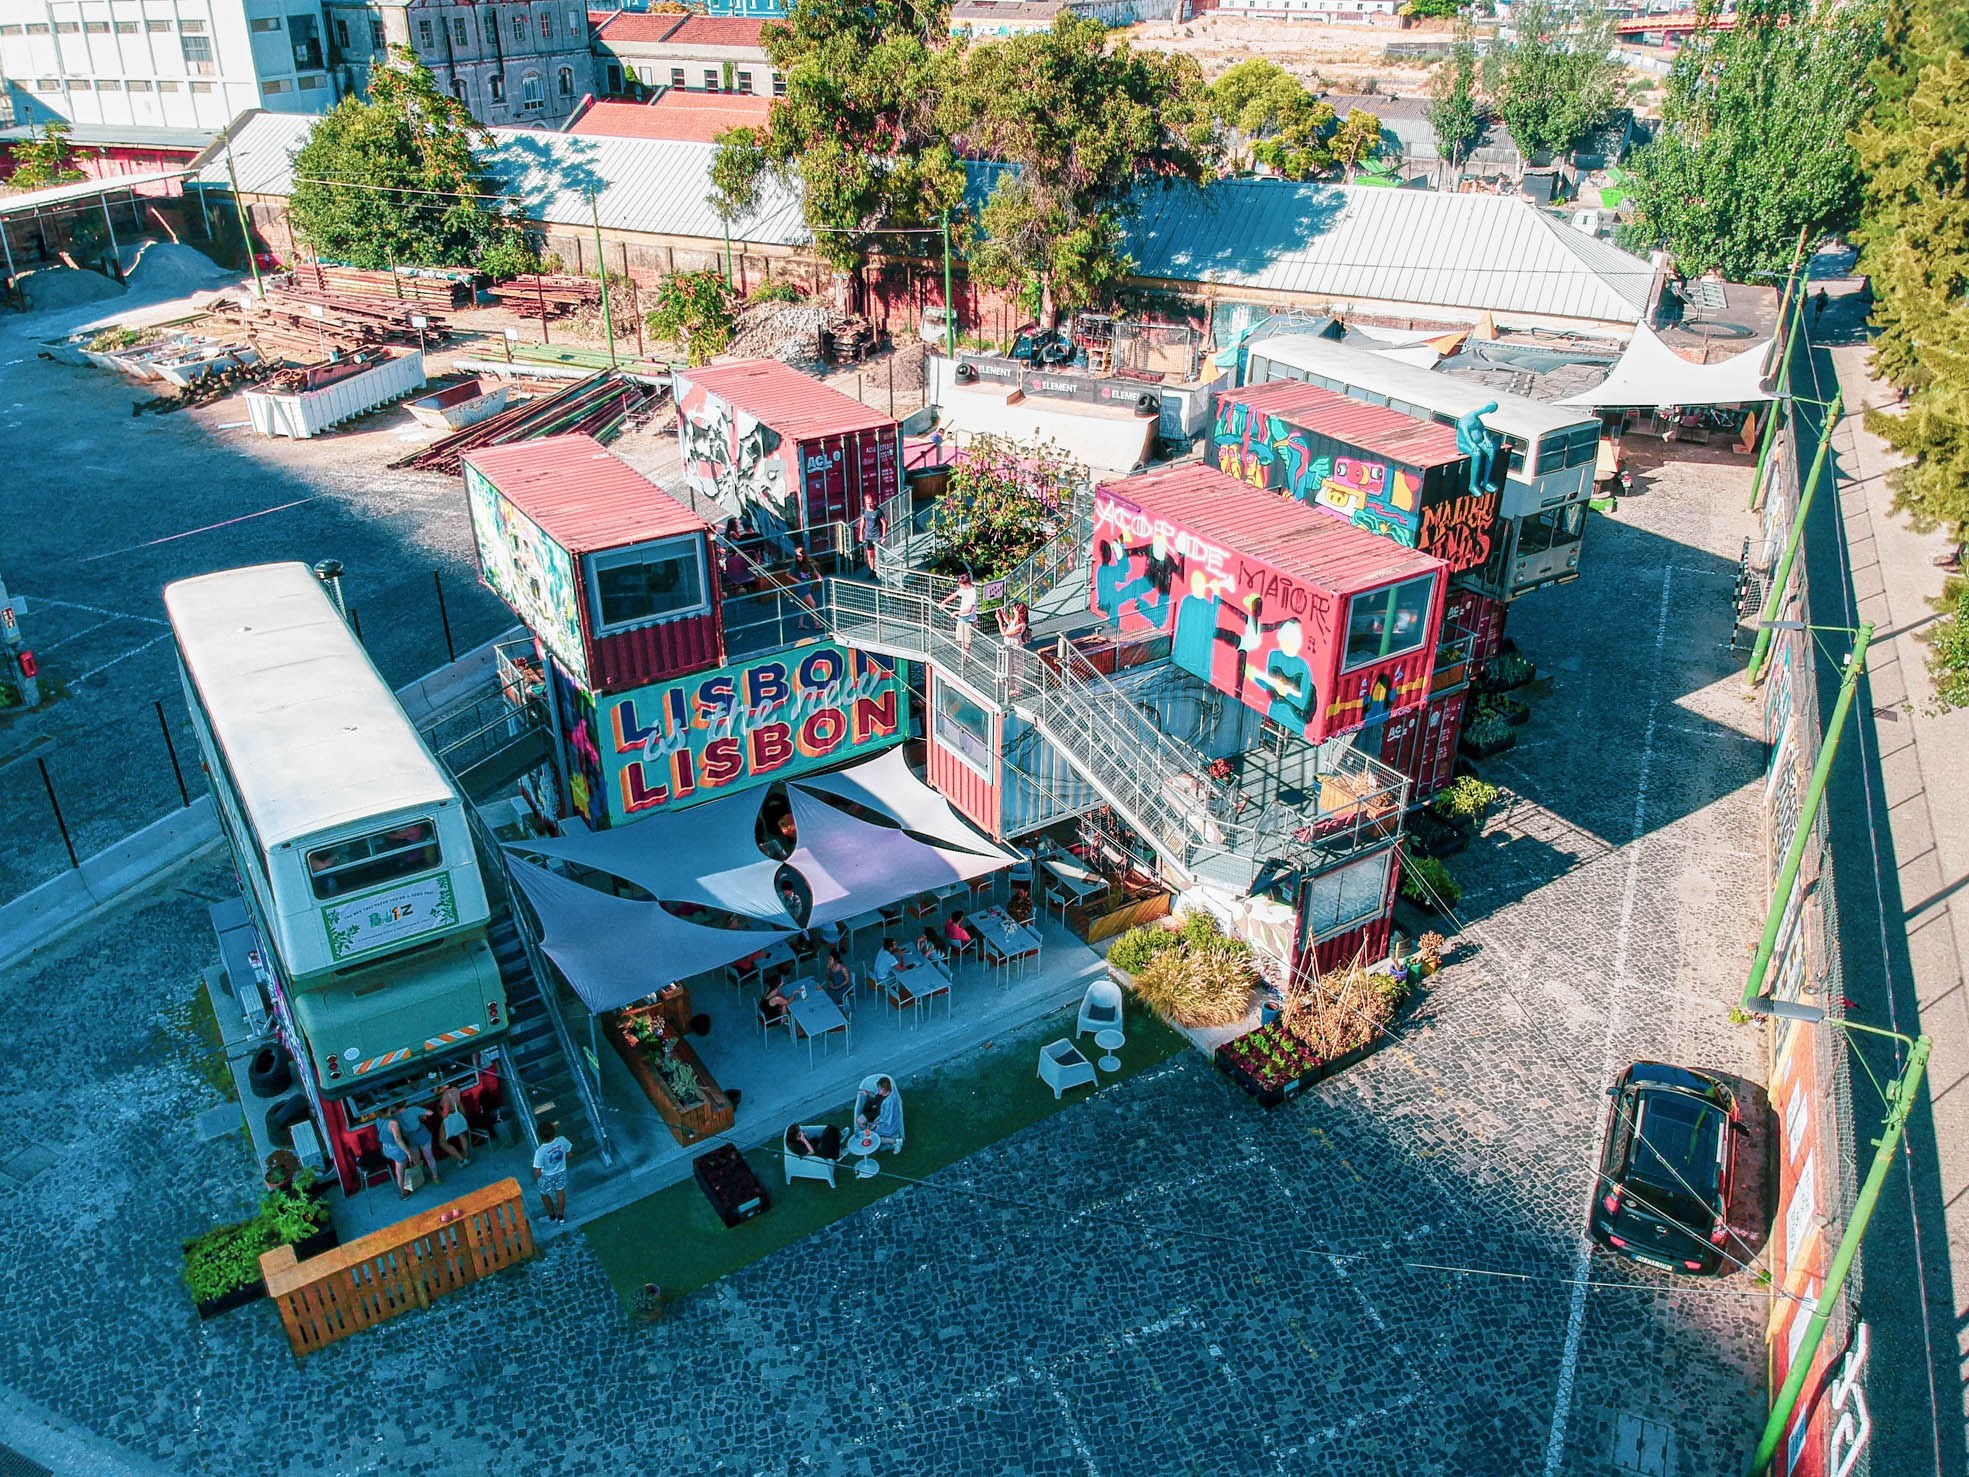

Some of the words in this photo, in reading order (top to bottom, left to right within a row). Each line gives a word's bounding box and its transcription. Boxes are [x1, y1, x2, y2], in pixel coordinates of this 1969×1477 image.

[978, 364, 1011, 377] ELEMENT
[1042, 382, 1078, 394] ELEMENT
[611, 647, 896, 752] LISBON
[619, 690, 899, 813] LISBON
